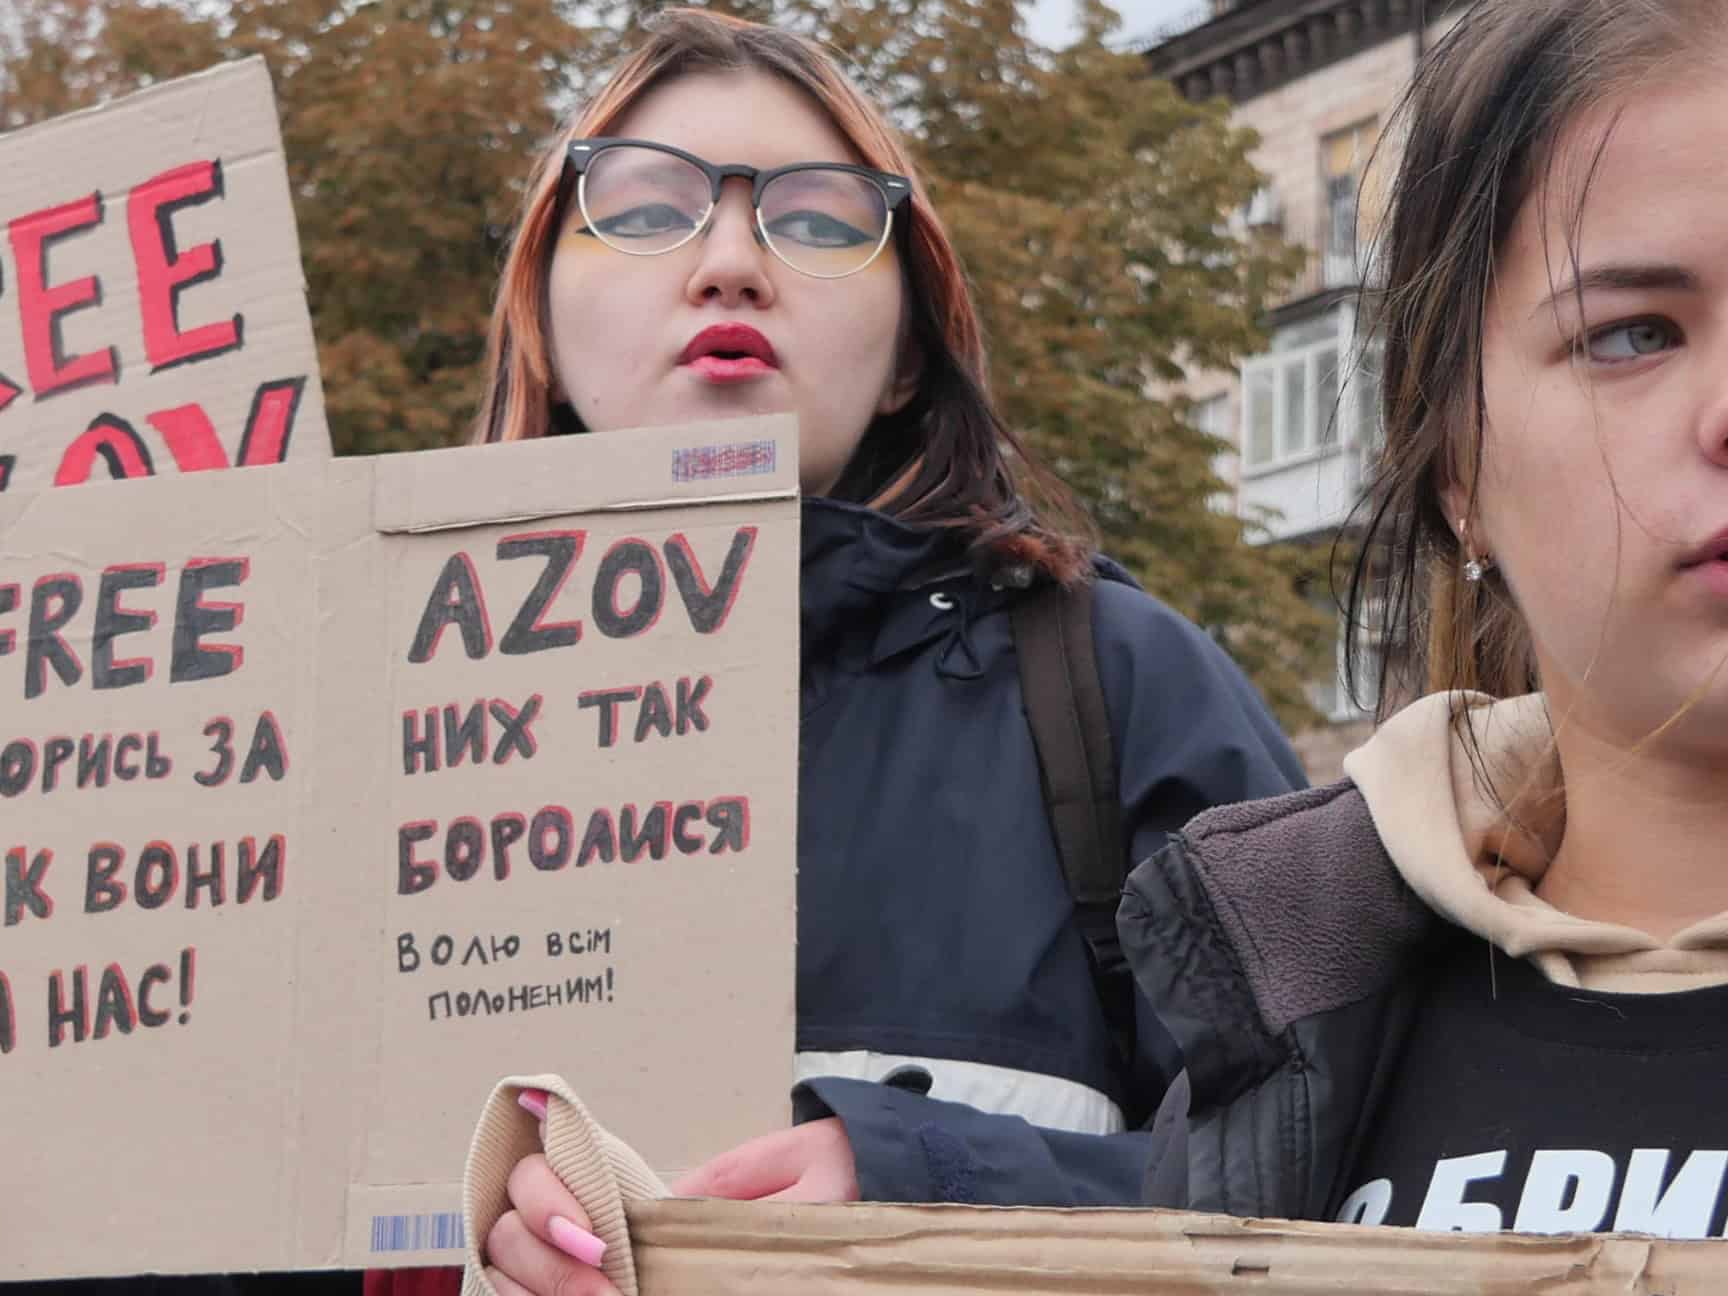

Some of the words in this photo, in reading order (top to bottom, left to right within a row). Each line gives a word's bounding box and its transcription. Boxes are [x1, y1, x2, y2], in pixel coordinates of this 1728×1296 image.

[407, 525, 759, 664] AZOV
[193, 709, 290, 788] ЗА
[402, 693, 544, 776] НИХ
[577, 674, 713, 749] ТАК
[84, 833, 286, 914] ВОНИ
[397, 795, 750, 896] БОРОЛИСЯ
[47, 945, 197, 1049] НАС!
